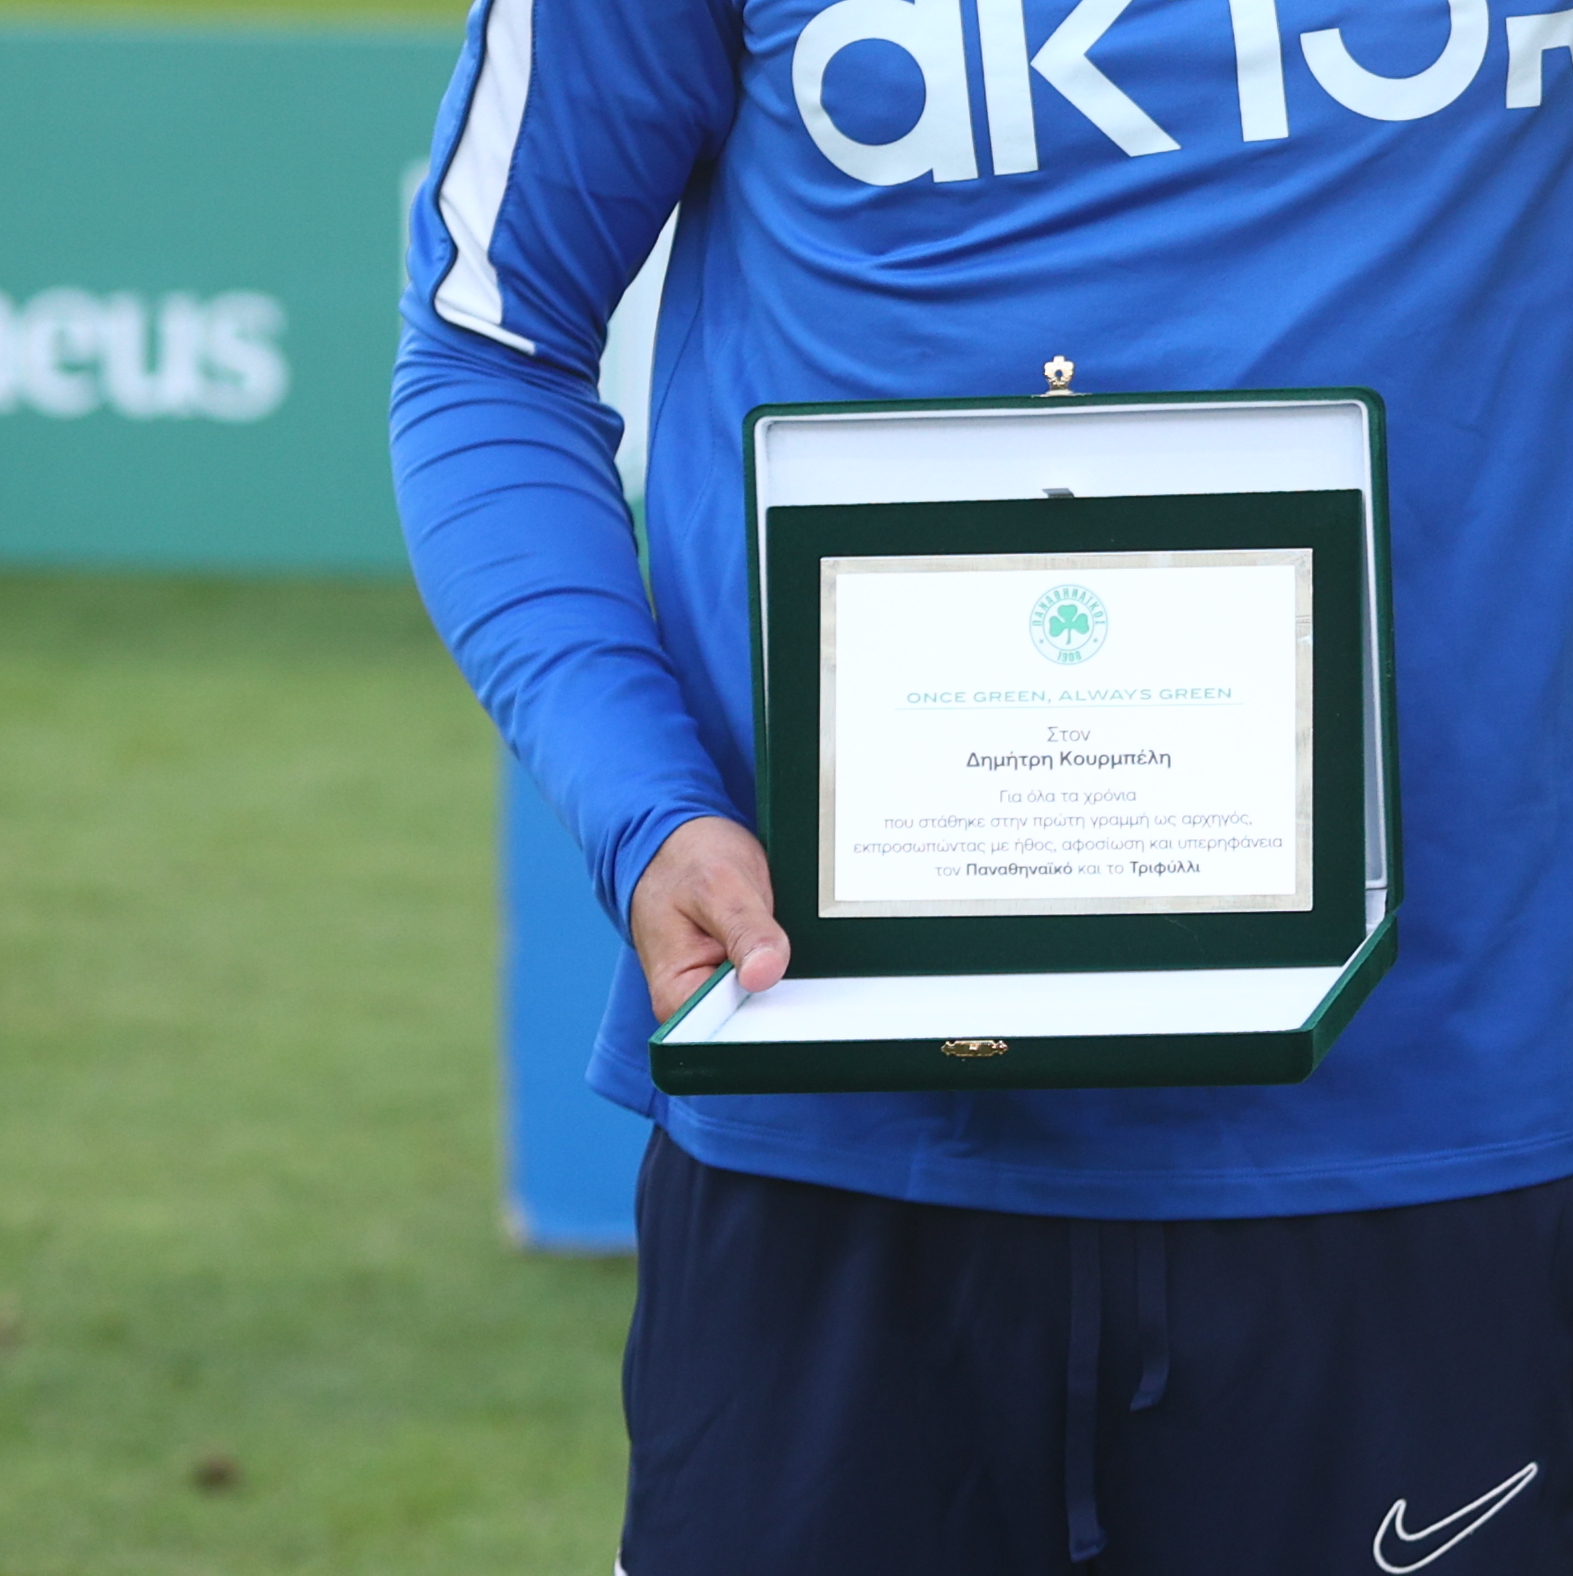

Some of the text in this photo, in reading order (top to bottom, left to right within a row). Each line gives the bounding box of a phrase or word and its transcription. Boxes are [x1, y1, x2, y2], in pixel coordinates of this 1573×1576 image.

[0, 287, 289, 421] cus
[1057, 650, 1082, 663] 1908
[906, 687, 1232, 705] ONCE GREEN, ALWAYS GREEN
[1046, 725, 1091, 743] Στον
[965, 749, 1172, 772] Δημήτρη Κουρμπέλη
[999, 788, 1137, 806] Για όλα τα χρόνια
[883, 810, 1253, 832] που στάθηκε στην πρώτη γραμμή ως αρχηγός,
[853, 834, 1283, 857] εκπροσωπώντας με ήθος, αφοσίωση και υπερηφάνεια
[934, 859, 1201, 879] τον Παναθηναϊκό και το Τριφύλλι
